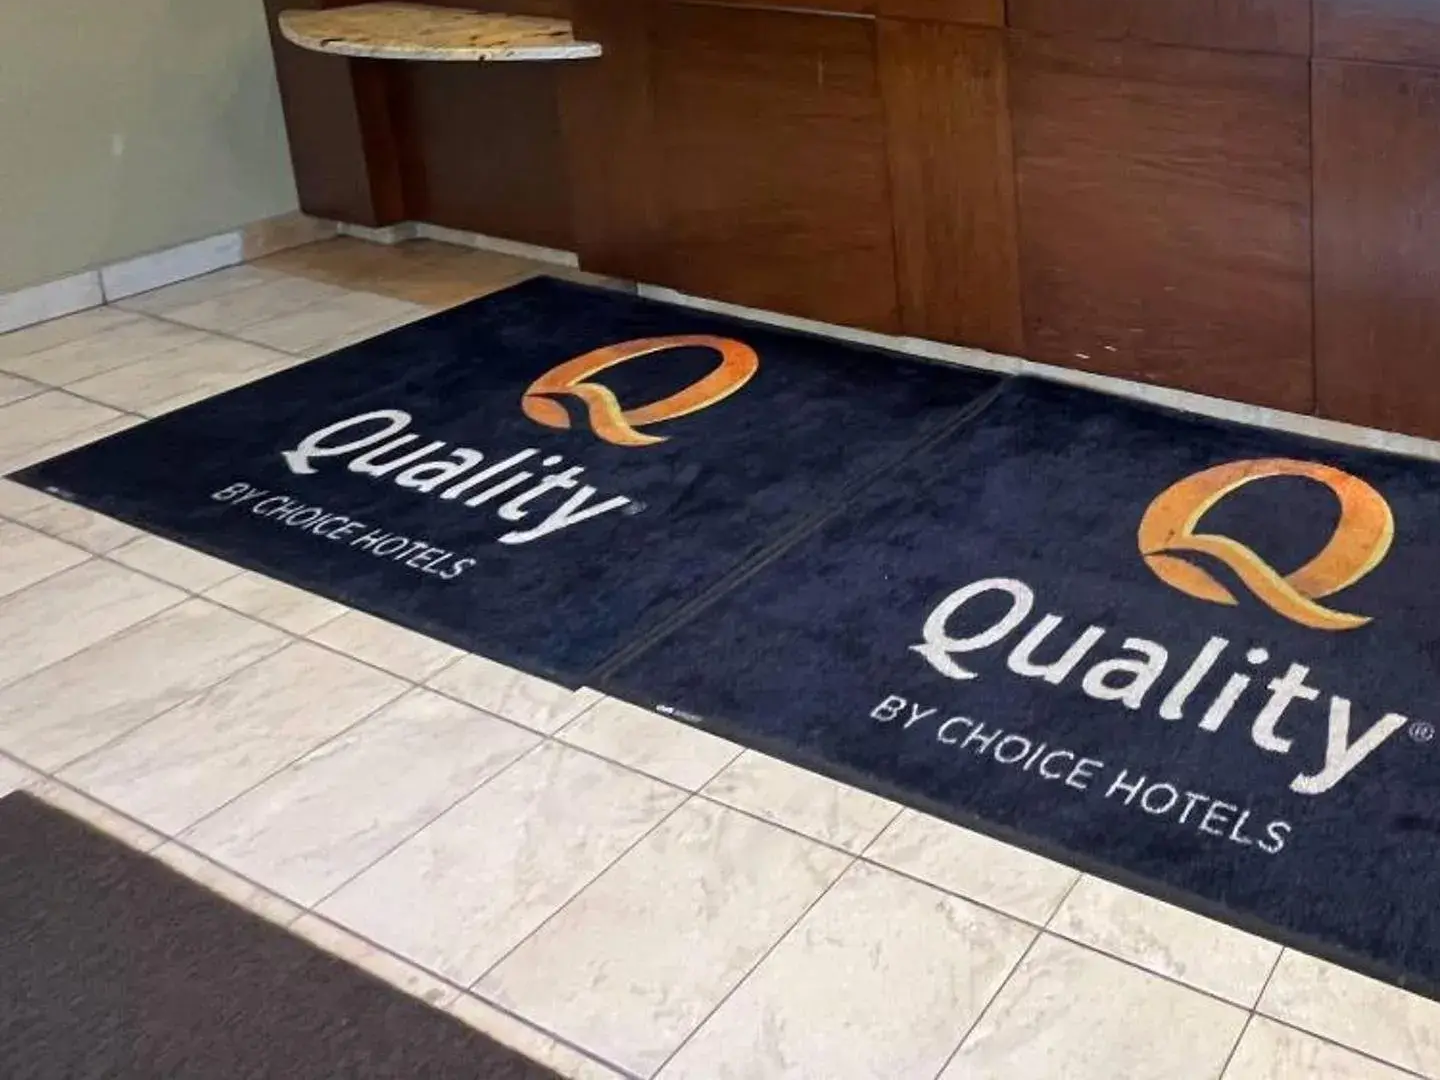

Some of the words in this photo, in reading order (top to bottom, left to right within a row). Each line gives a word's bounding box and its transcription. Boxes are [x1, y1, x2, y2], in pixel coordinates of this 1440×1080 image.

[523, 335, 760, 446] Q
[212, 482, 270, 515] BY
[251, 495, 363, 543] CHOICE
[352, 528, 478, 581] HOTELS
[282, 409, 631, 545] Quality
[1138, 458, 1394, 631] Q
[909, 576, 1409, 795] Quality
[869, 694, 937, 730] BY
[937, 715, 1104, 790] CHOICE
[1105, 769, 1292, 855] HOTELS
